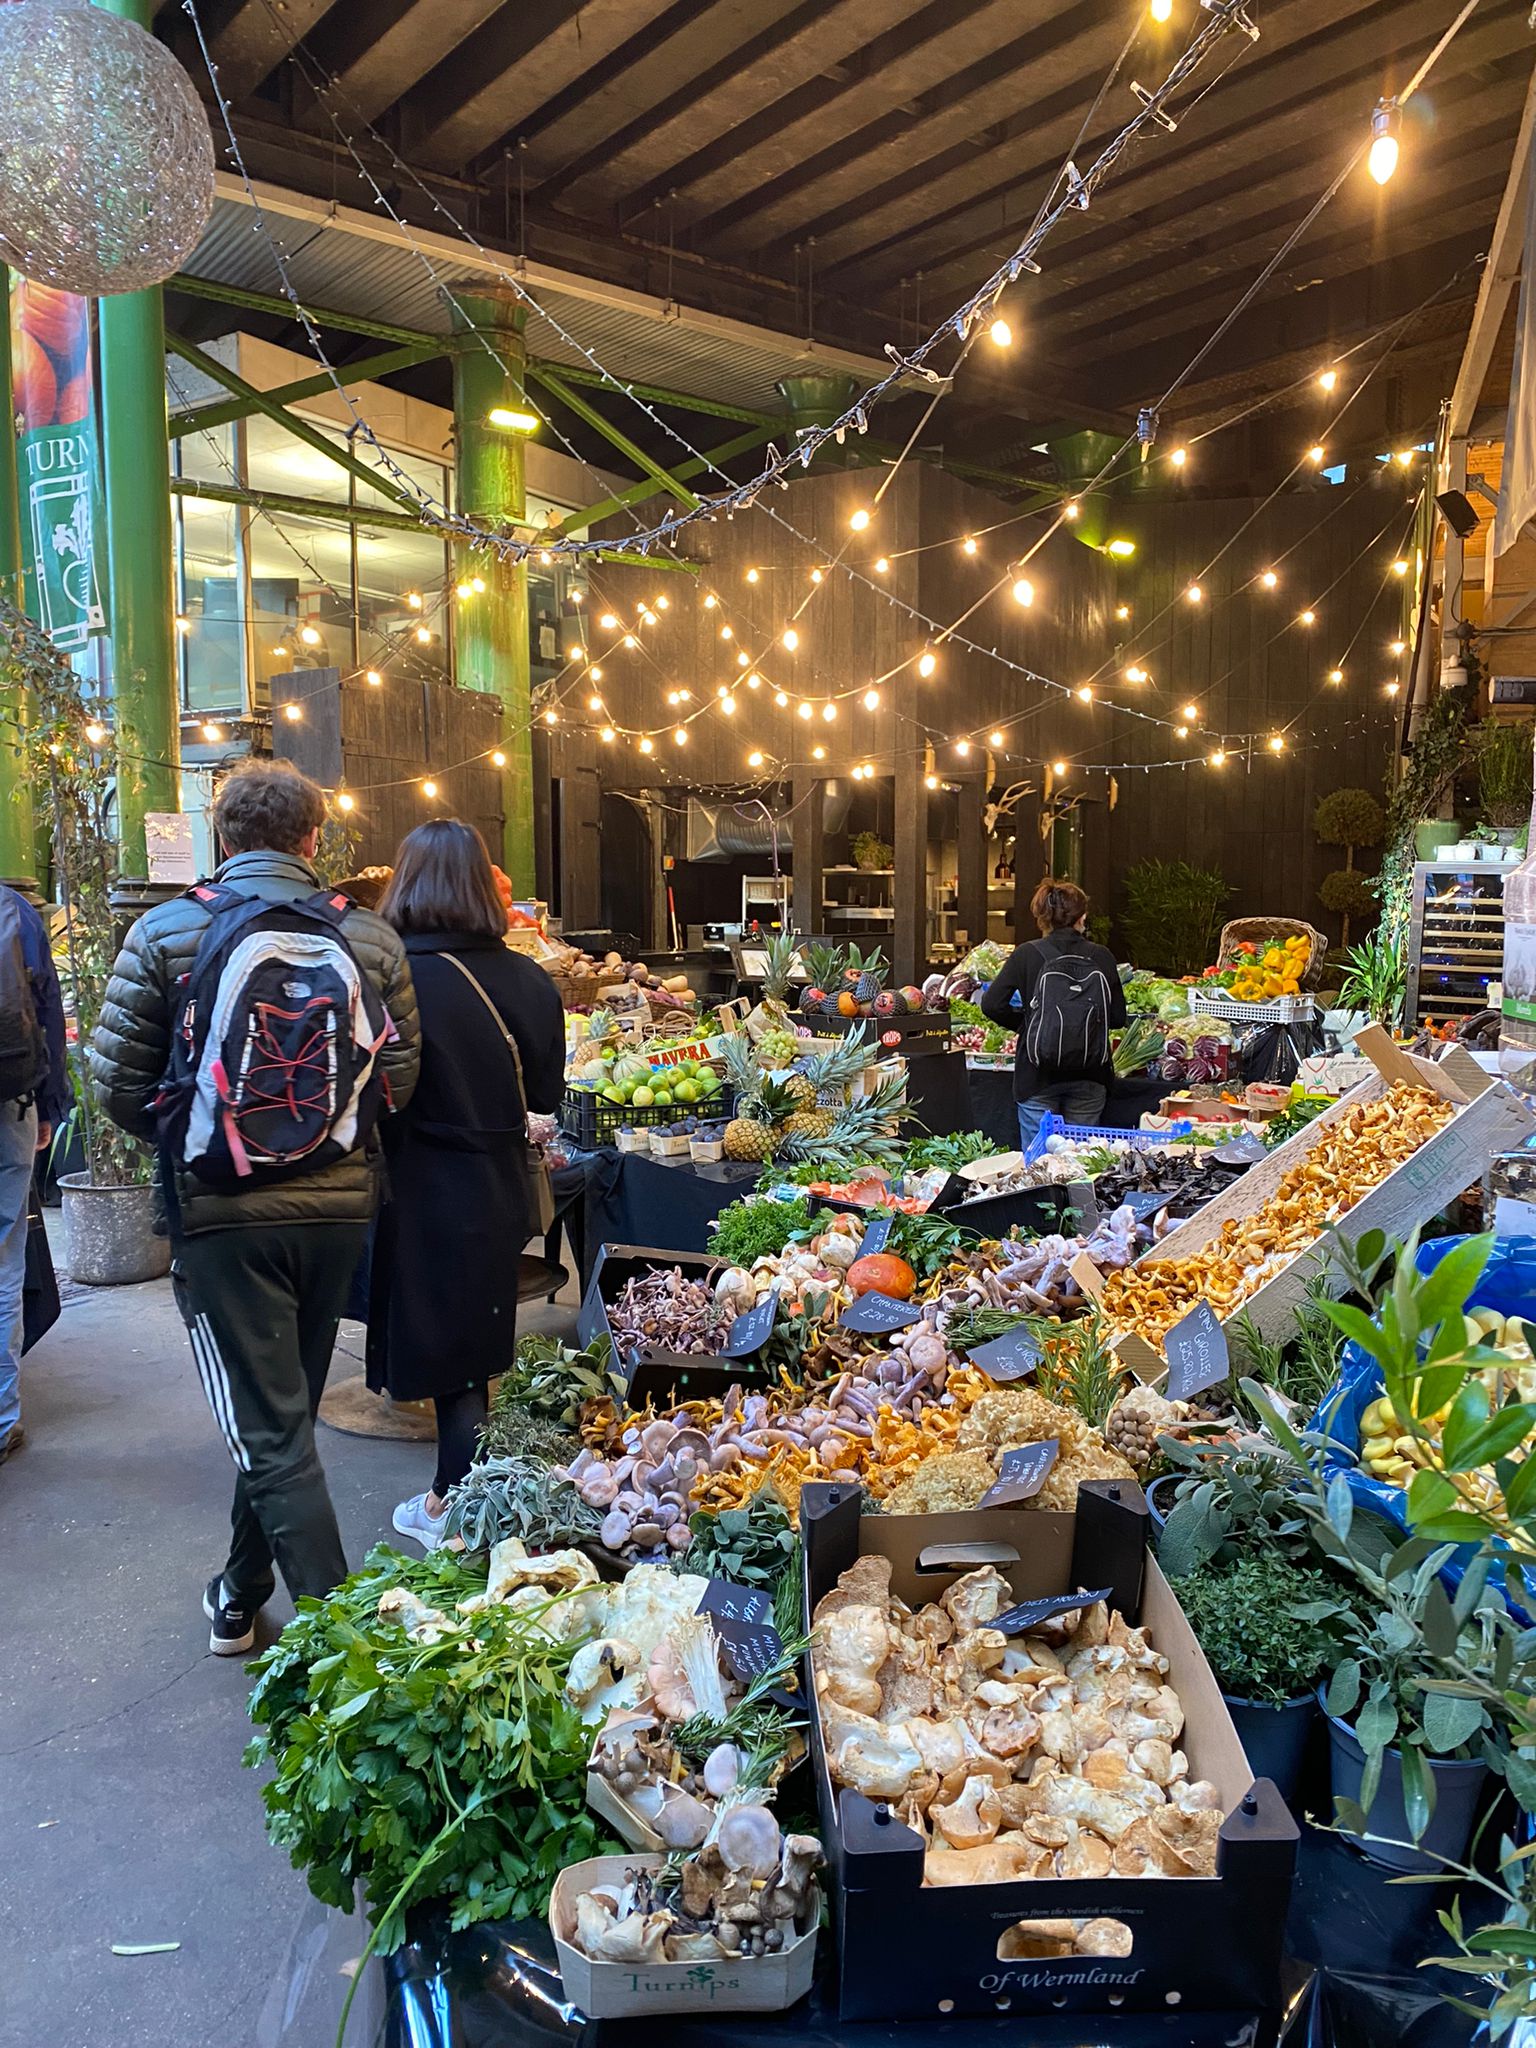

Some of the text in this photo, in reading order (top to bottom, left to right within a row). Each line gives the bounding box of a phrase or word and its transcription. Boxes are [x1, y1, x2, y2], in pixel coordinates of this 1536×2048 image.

[1051, 1907, 1064, 1915] the
[622, 1968, 740, 2000] Turnips
[979, 1967, 1146, 1994] Of Wermland
